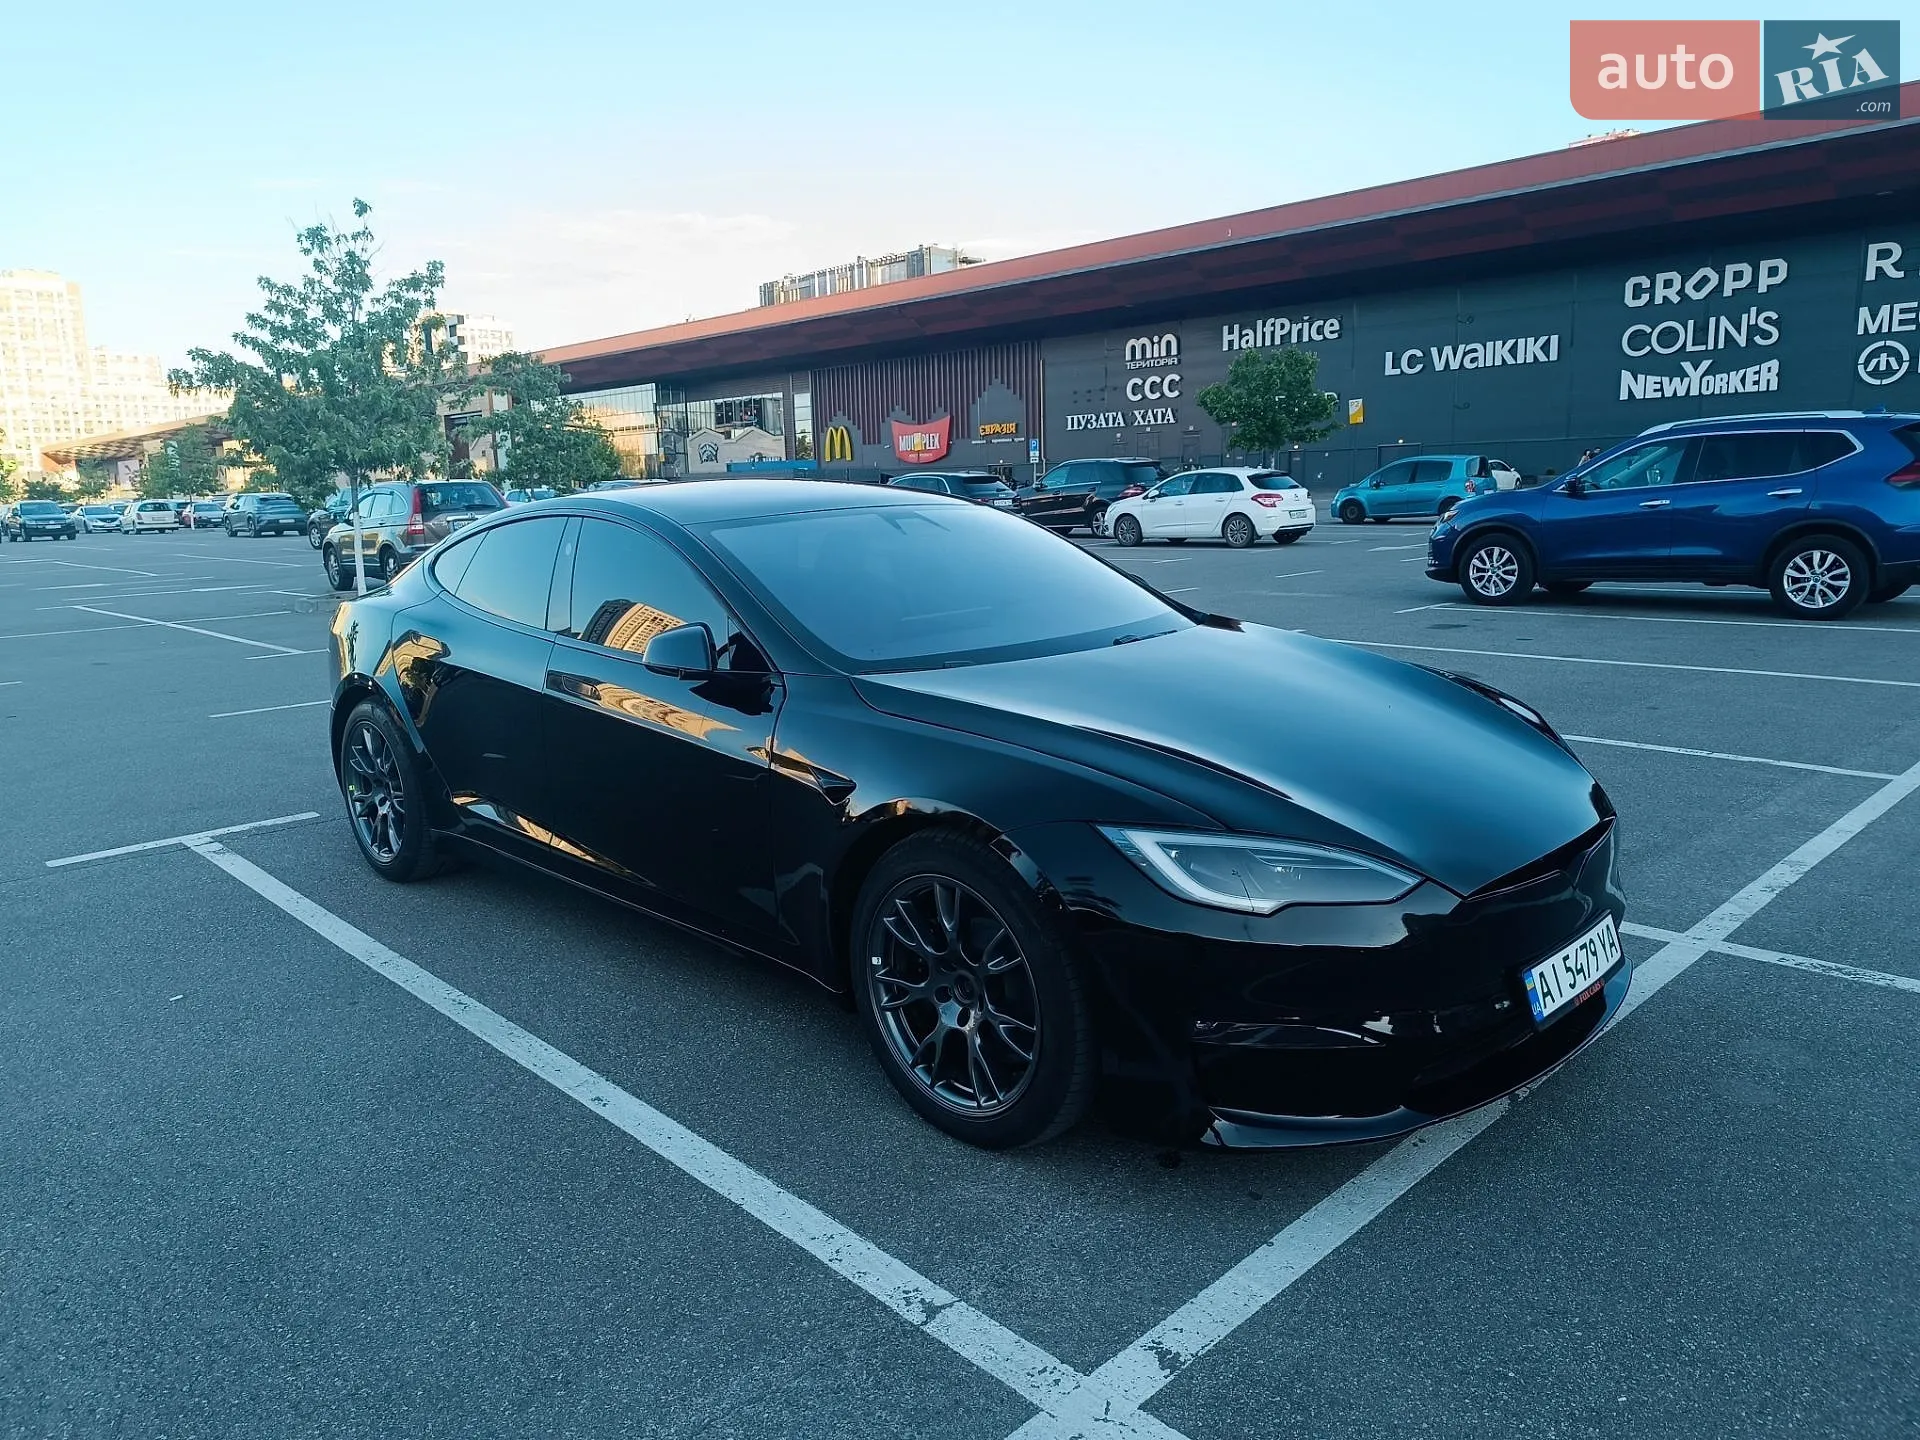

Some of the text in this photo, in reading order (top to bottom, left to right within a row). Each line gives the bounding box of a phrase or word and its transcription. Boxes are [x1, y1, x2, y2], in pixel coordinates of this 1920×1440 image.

[1624, 258, 1788, 308] CROPP
[1222, 316, 1341, 351] HalfPrice
[1621, 306, 1779, 357] COLIN'S
[1857, 301, 1920, 336] ME
[1125, 357, 1178, 370] ТЕРИТОРІЯ
[1384, 348, 1424, 376] LC
[1126, 373, 1181, 402] CCC
[1065, 407, 1176, 431] ПУЗАТА ХАТА
[1538, 924, 1618, 1010] AI 5479 YA
[1531, 1001, 1542, 1016] UA
